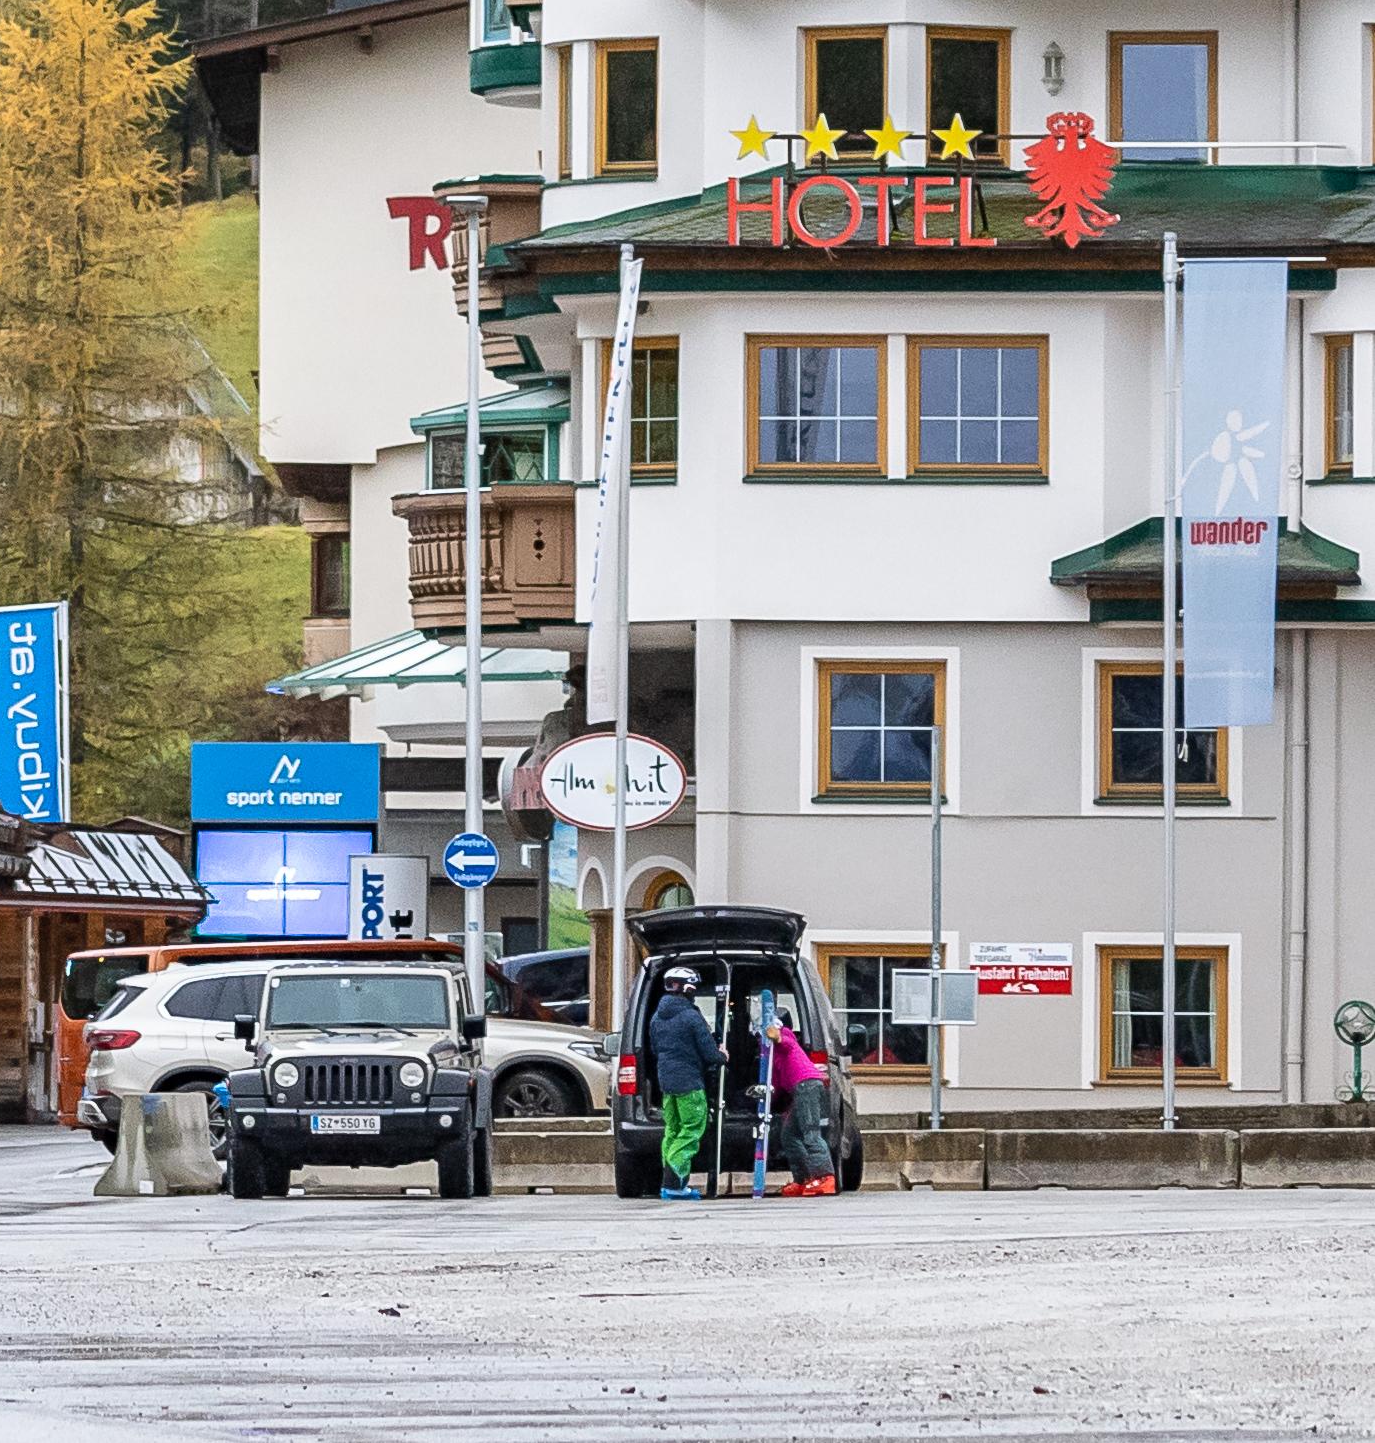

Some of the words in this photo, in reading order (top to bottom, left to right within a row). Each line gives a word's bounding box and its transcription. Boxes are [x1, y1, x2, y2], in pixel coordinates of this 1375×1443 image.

[727, 176, 998, 248] HOTEL
[1189, 516, 1269, 546] wander
[226, 789, 275, 808] sport
[279, 791, 343, 806] nenner
[1017, 966, 1070, 981] Freihalten!
[320, 1117, 333, 1129] SZ
[340, 1117, 361, 1129] 550
[362, 1117, 376, 1129] YG
